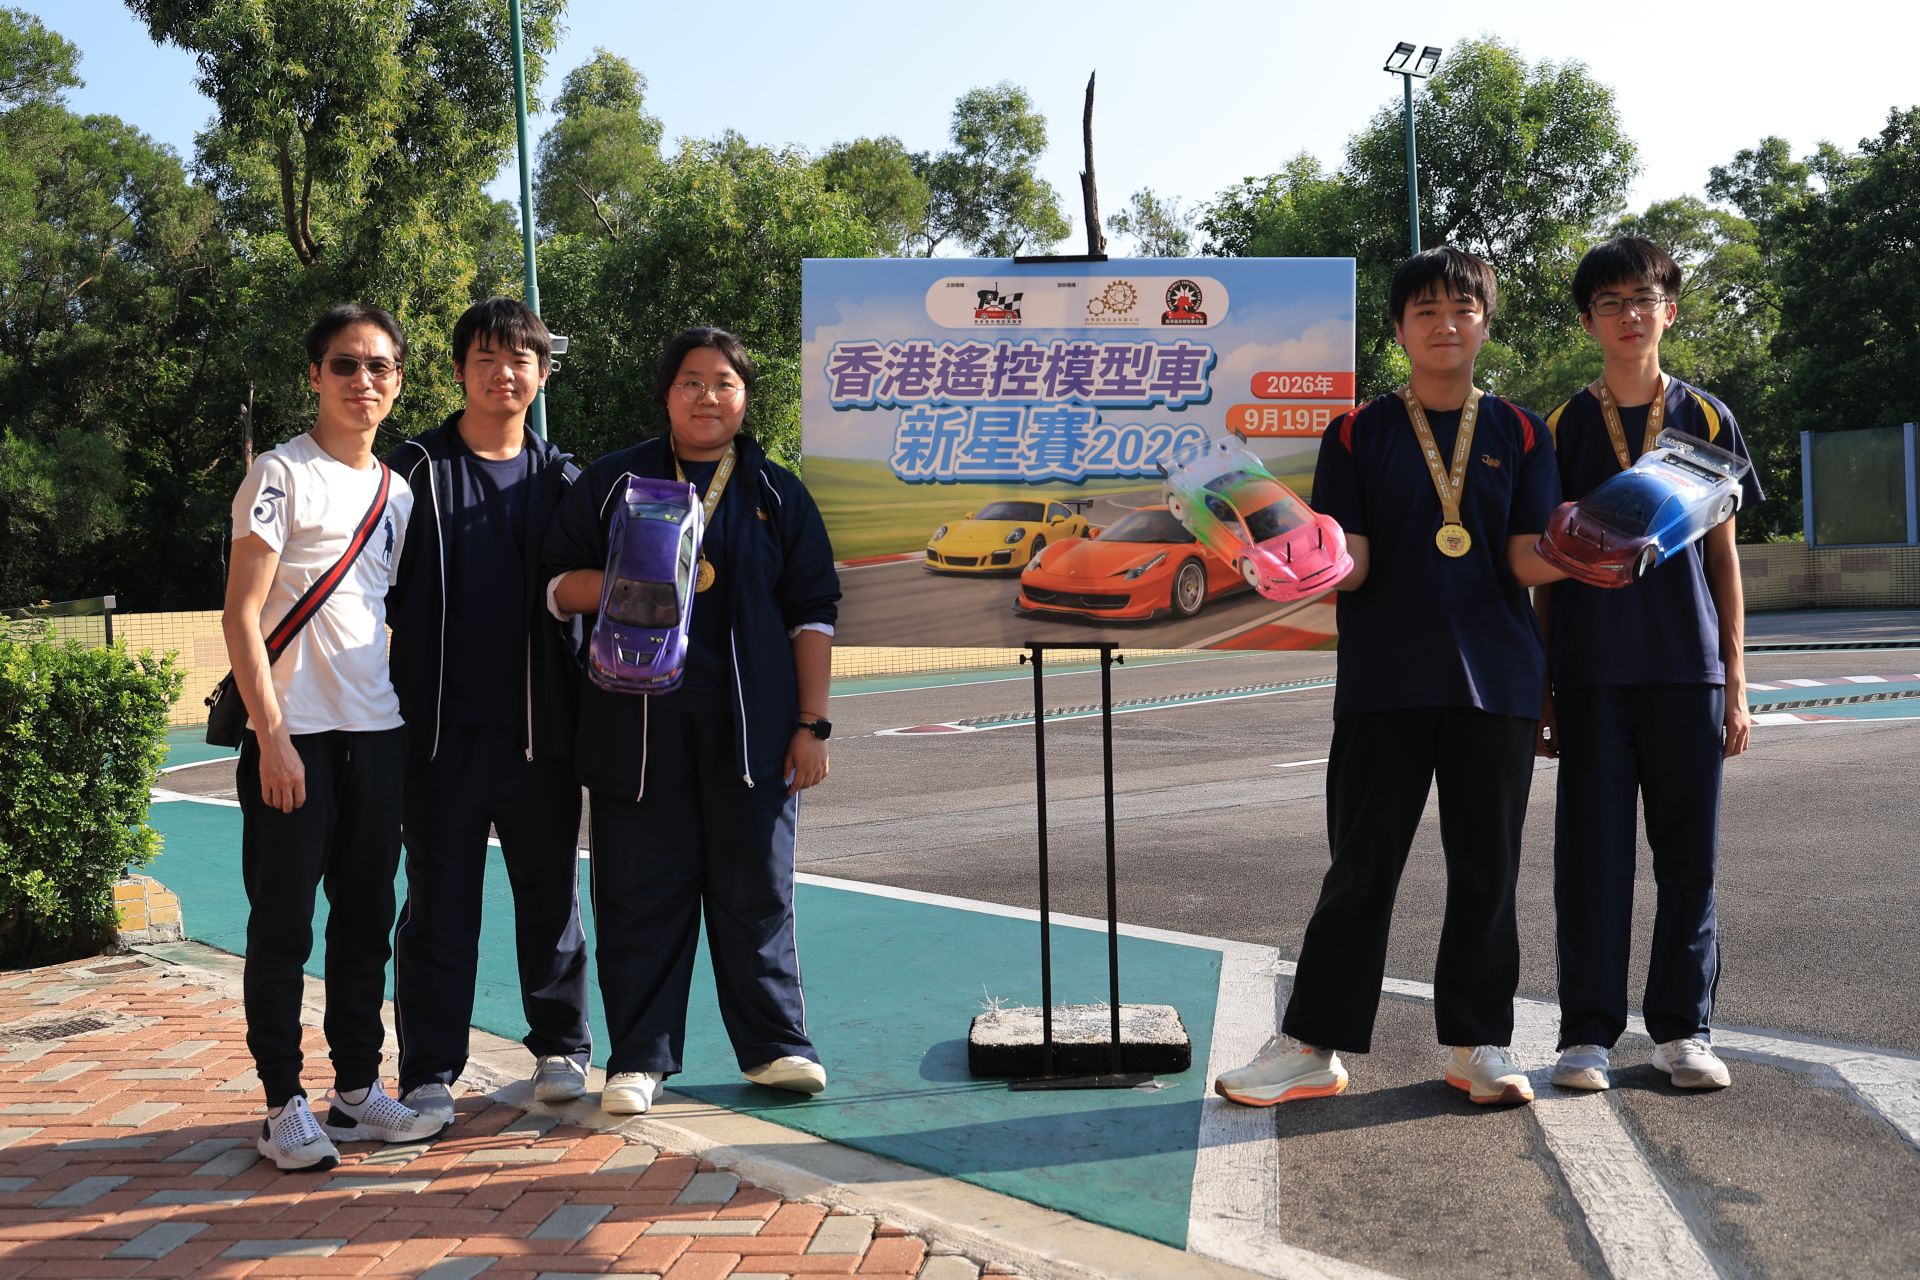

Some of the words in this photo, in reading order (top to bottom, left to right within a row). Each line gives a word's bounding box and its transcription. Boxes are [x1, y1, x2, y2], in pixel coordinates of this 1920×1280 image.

[829, 343, 1208, 398] 香港遙控模型車
[1266, 374, 1334, 396] 2026年
[1244, 408, 1331, 432] 9月19日
[253, 486, 286, 524] 3
